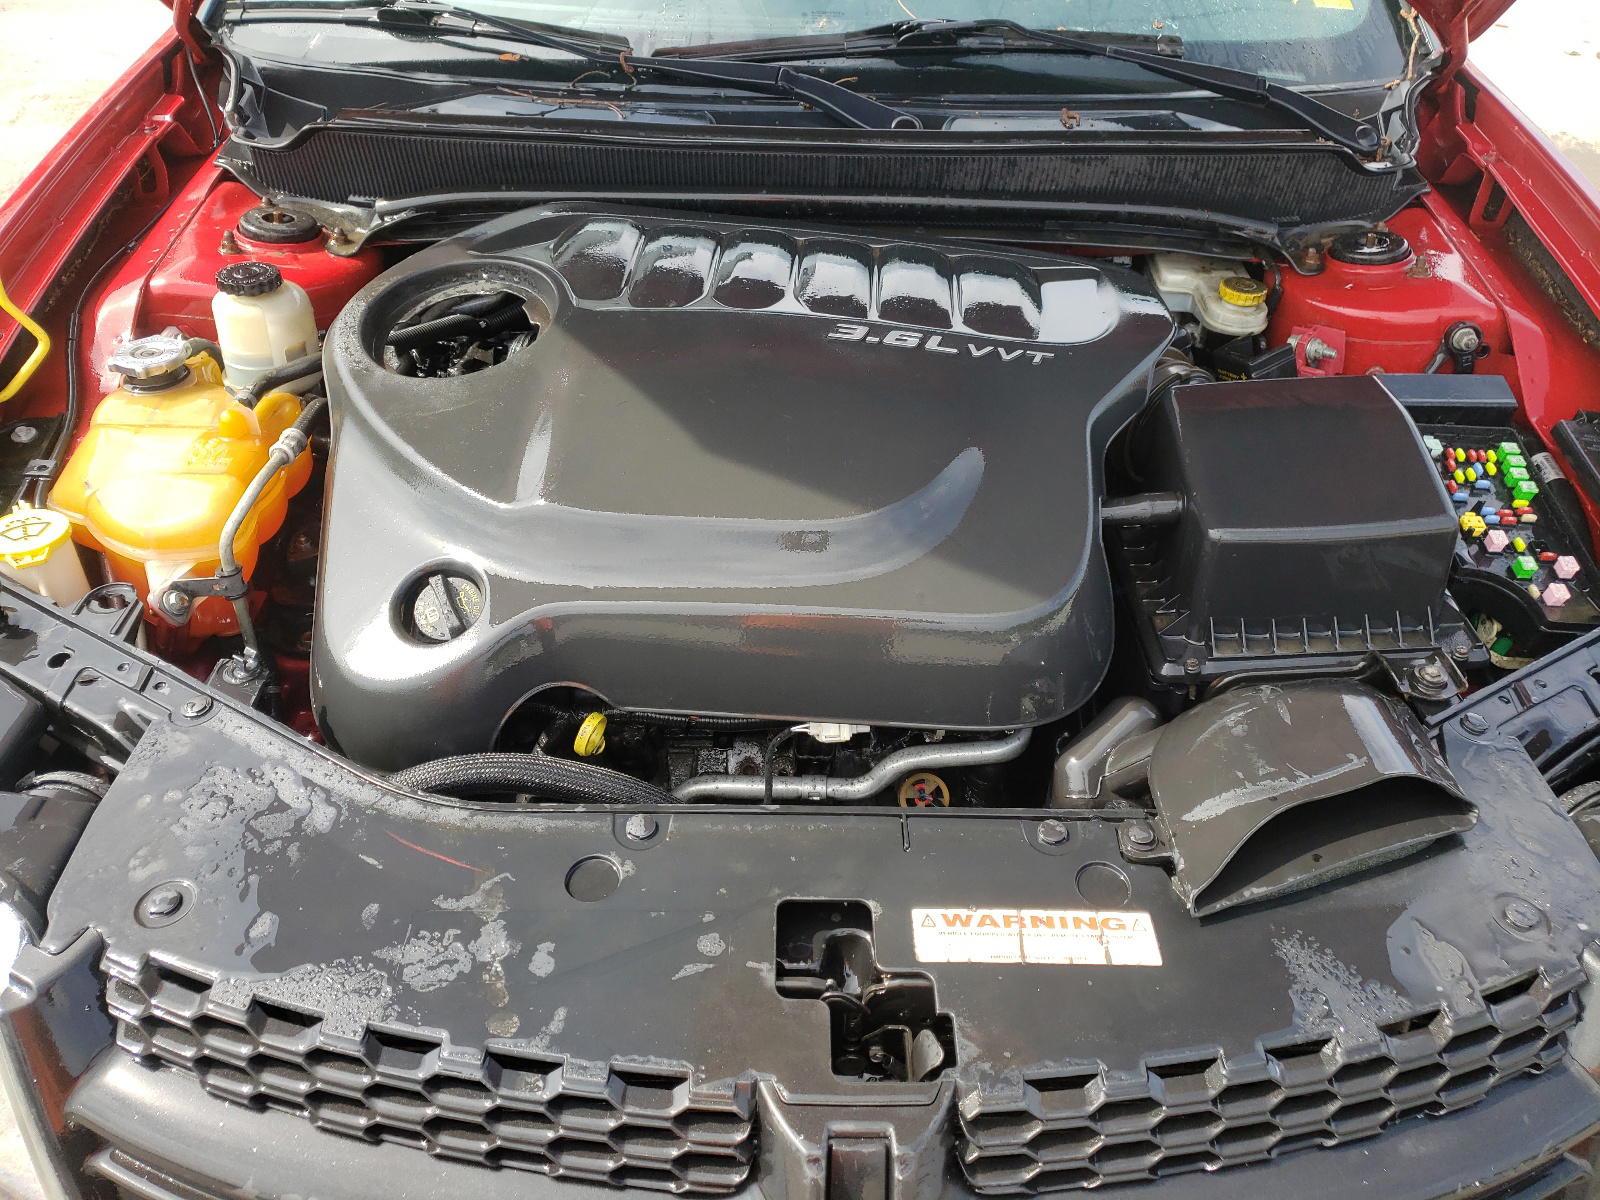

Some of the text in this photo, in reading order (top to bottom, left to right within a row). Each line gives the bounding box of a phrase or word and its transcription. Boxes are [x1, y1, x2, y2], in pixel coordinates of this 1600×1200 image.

[827, 323, 1055, 366] 3.6L VVT
[461, 583, 480, 602] ENGINE
[940, 913, 1127, 931] WARNING
